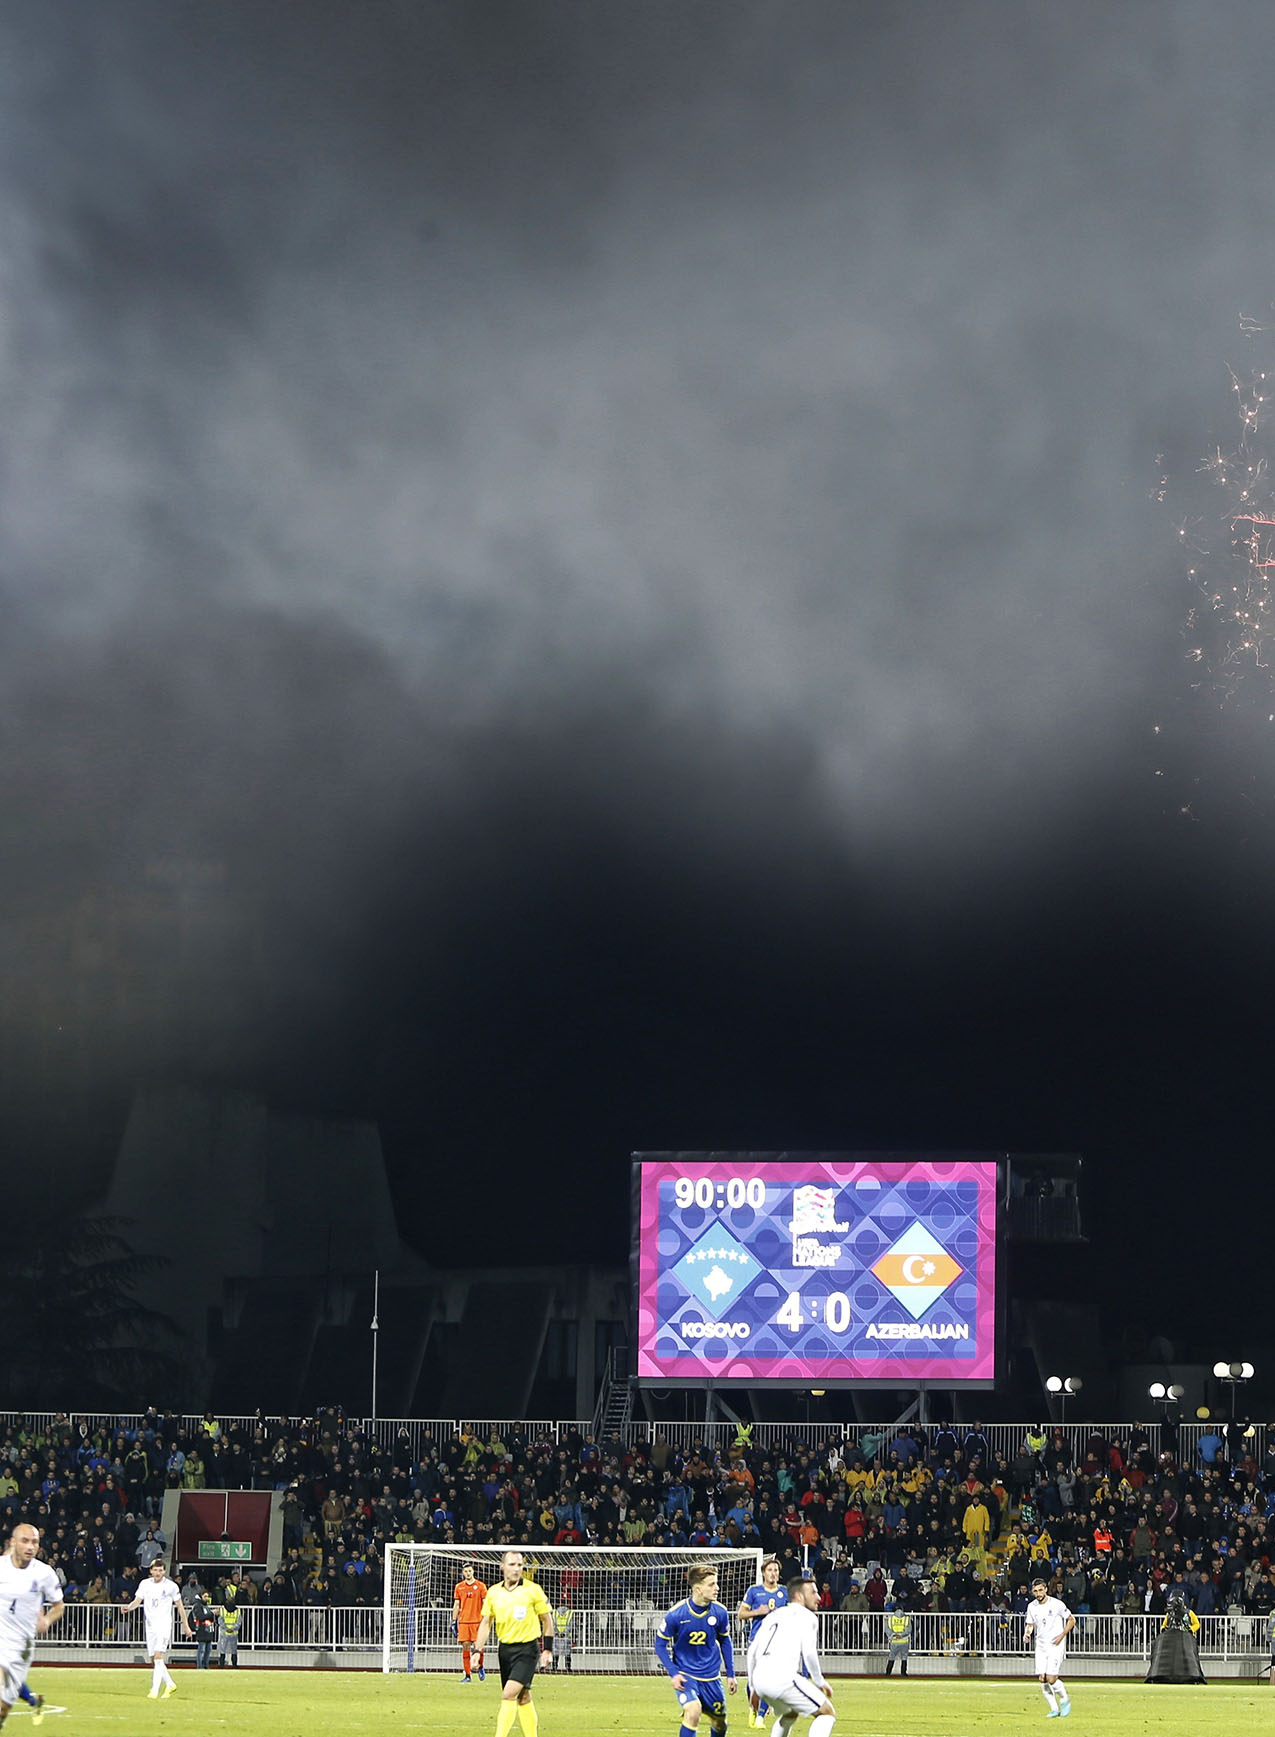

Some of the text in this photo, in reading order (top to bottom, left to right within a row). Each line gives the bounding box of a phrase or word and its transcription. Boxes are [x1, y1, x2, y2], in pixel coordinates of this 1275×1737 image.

[674, 1177, 766, 1209] 90:00
[681, 1322, 750, 1339] KOSOVO
[865, 1323, 969, 1340] AZERBAIJAN
[151, 1598, 159, 1608] 10
[768, 1597, 776, 1610] 6
[688, 1631, 707, 1645] 22
[762, 1622, 779, 1656] 2
